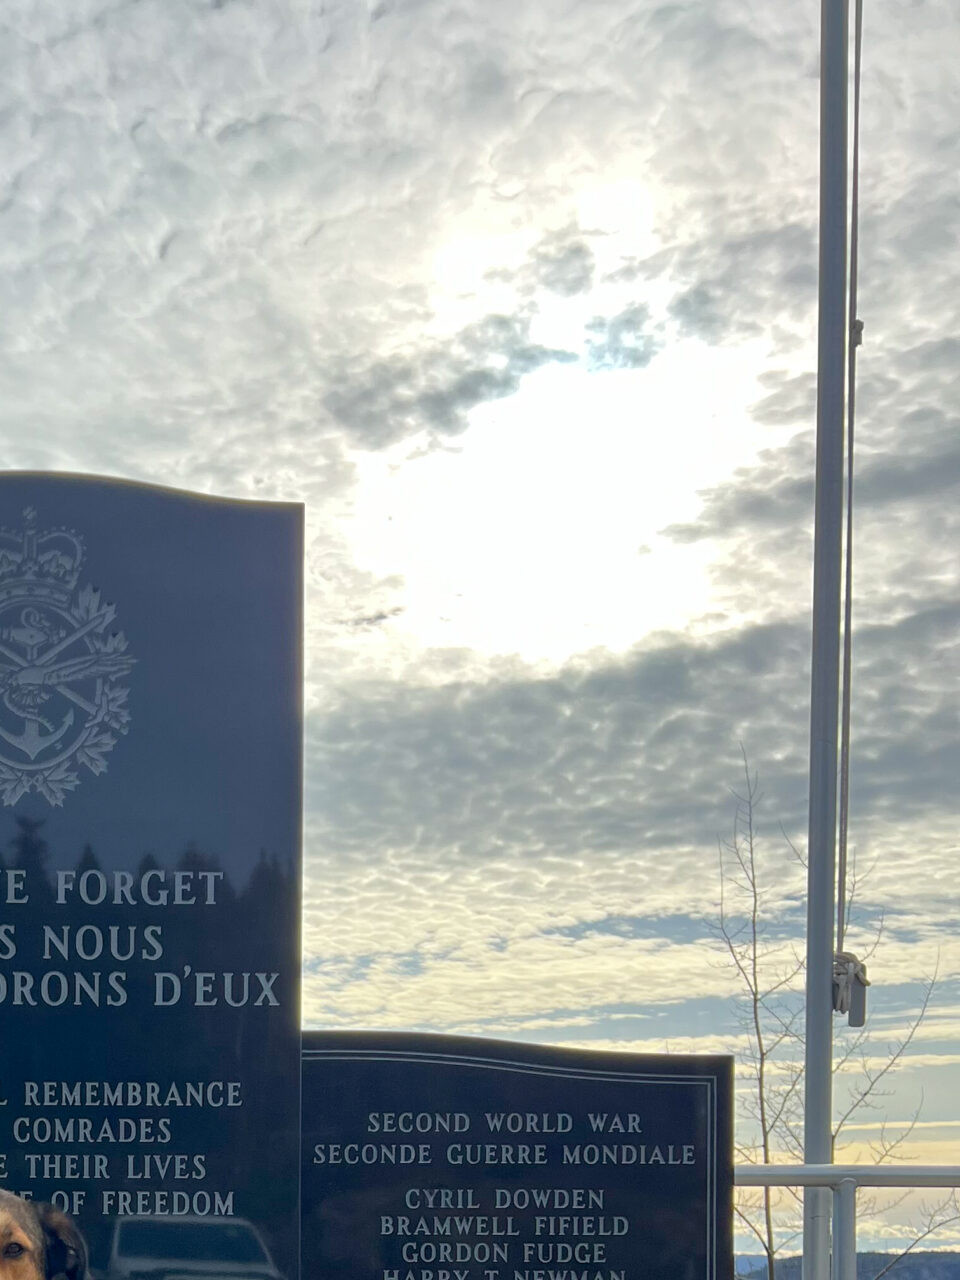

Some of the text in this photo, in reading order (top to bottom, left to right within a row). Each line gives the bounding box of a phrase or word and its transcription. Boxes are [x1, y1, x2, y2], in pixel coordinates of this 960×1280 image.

[55, 869, 225, 907] FORGET
[42, 924, 164, 961] NOUS
[23, 1080, 243, 1108] REMEMBRANCE
[12, 1117, 173, 1144] COMRADES
[367, 1112, 643, 1134] SECOND WORLD WAR
[24, 1154, 110, 1180] THEIR
[126, 1154, 207, 1180] LIVES
[312, 1144, 696, 1166] SECONDE GUERRE MONDIALE
[50, 1190, 86, 1216] OF
[101, 1190, 236, 1216] FREEDOM
[404, 1188, 606, 1210] CYRIL DOWDEN
[379, 1215, 631, 1237] BRAMWELL FIFIELD
[401, 1242, 607, 1264] GORDON FUDGE
